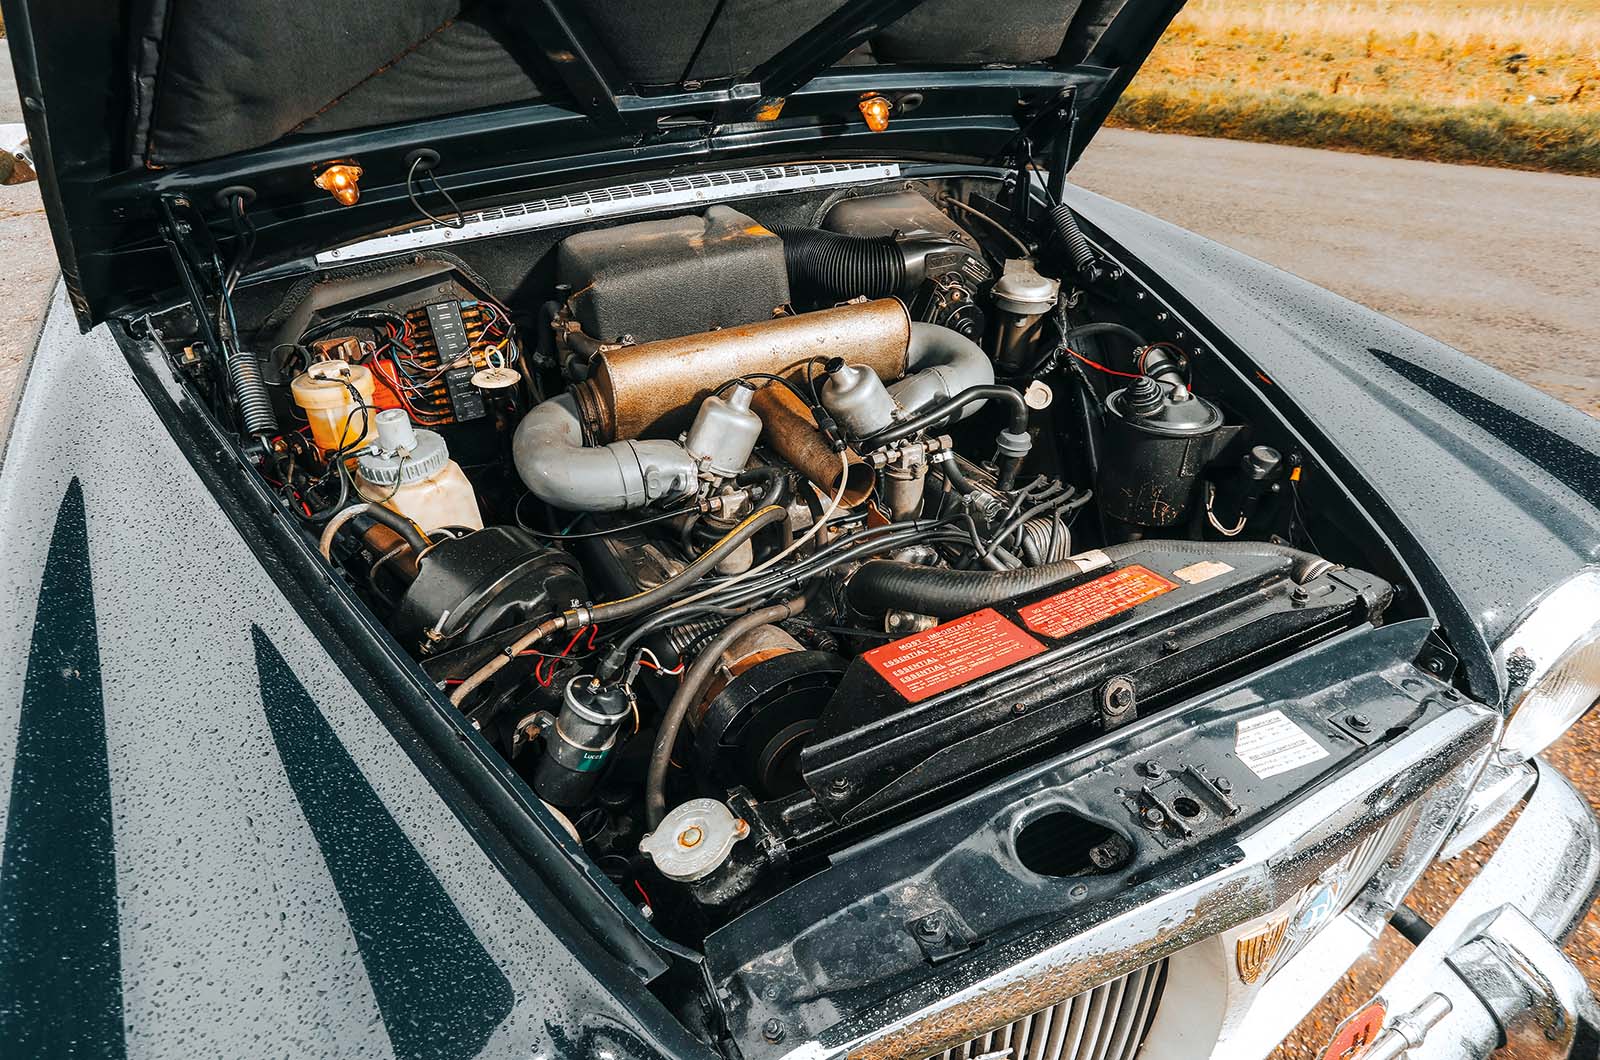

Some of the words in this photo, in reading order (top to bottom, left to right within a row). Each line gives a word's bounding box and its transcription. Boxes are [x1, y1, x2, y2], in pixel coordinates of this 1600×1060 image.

[898, 638, 924, 651] MOST
[882, 647, 928, 667] ESSENTIAL
[891, 655, 938, 676] ESSENTIAL
[899, 662, 946, 683] ESSENTIAL
